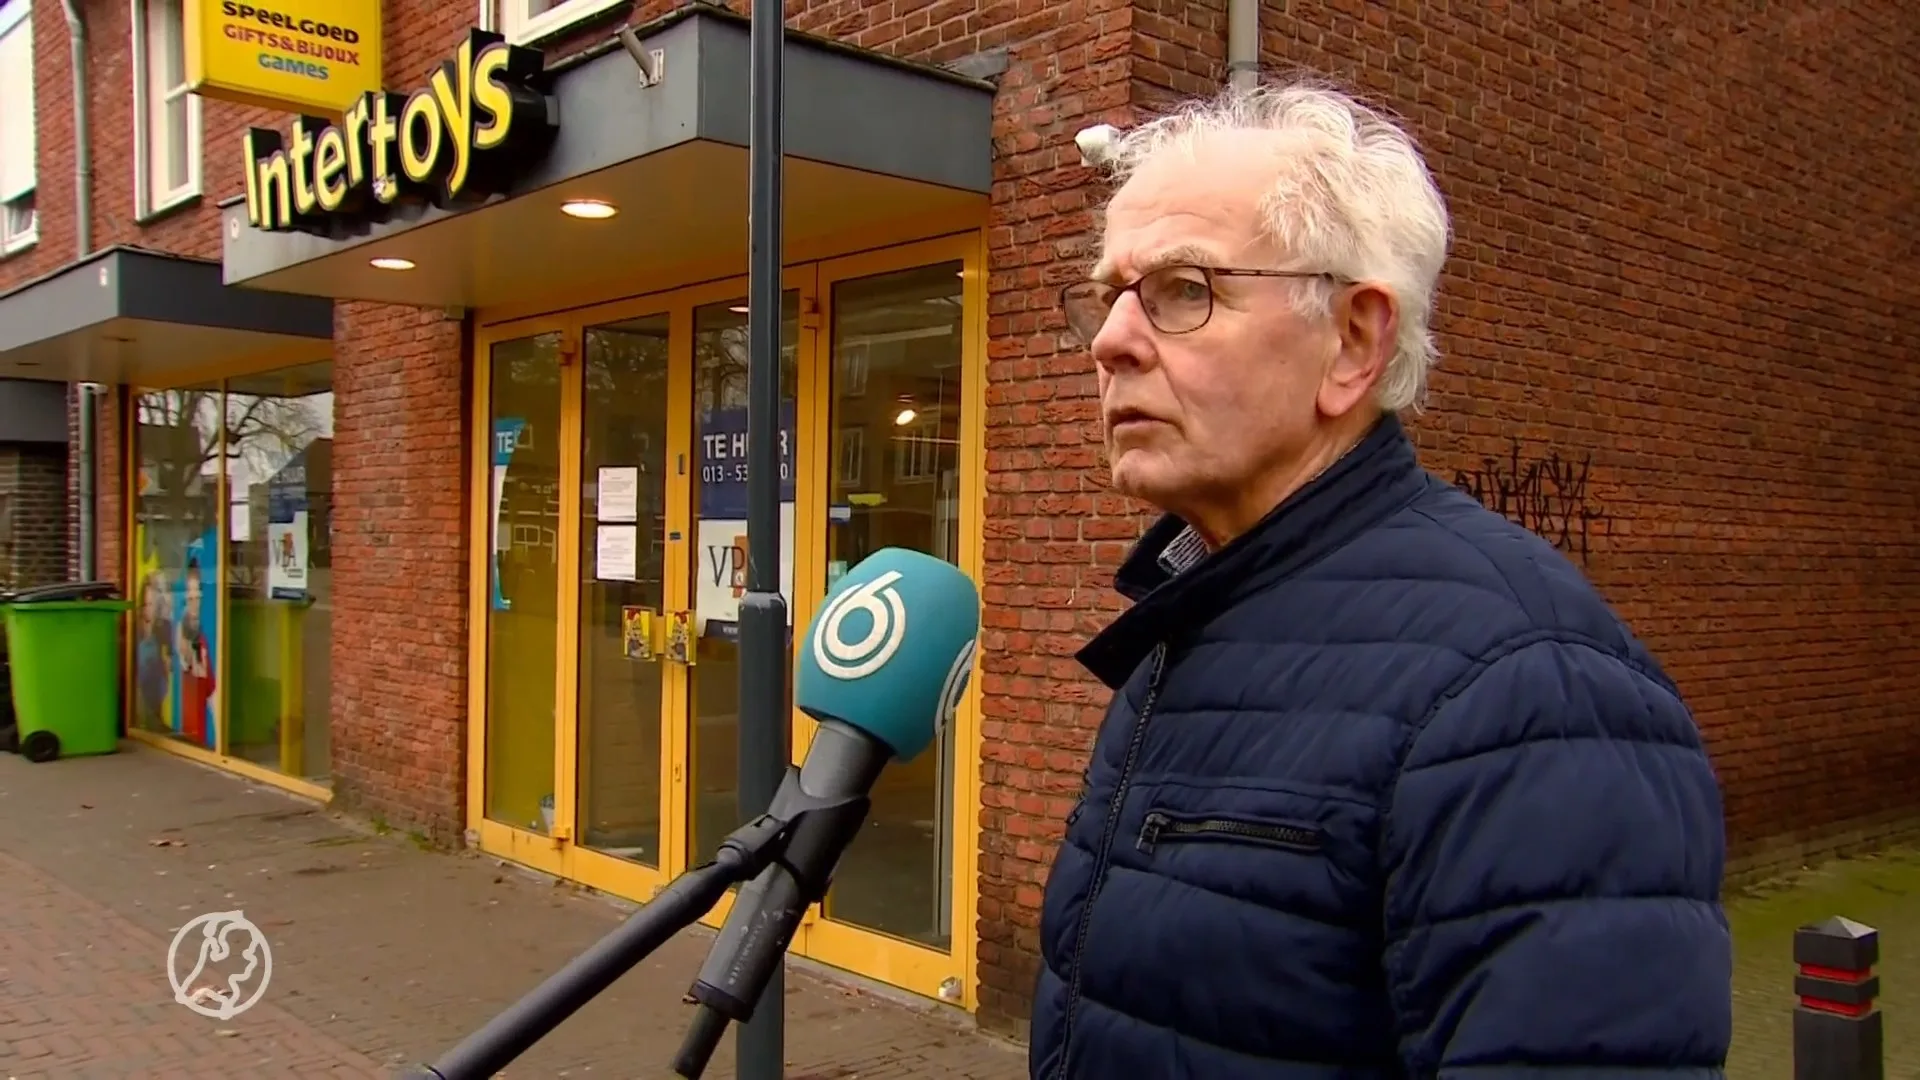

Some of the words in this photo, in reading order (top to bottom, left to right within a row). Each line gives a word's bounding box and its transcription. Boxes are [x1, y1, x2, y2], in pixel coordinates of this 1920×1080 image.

[242, 35, 514, 230] Intertoys
[703, 434, 727, 459] TE
[702, 465, 724, 482] 013
